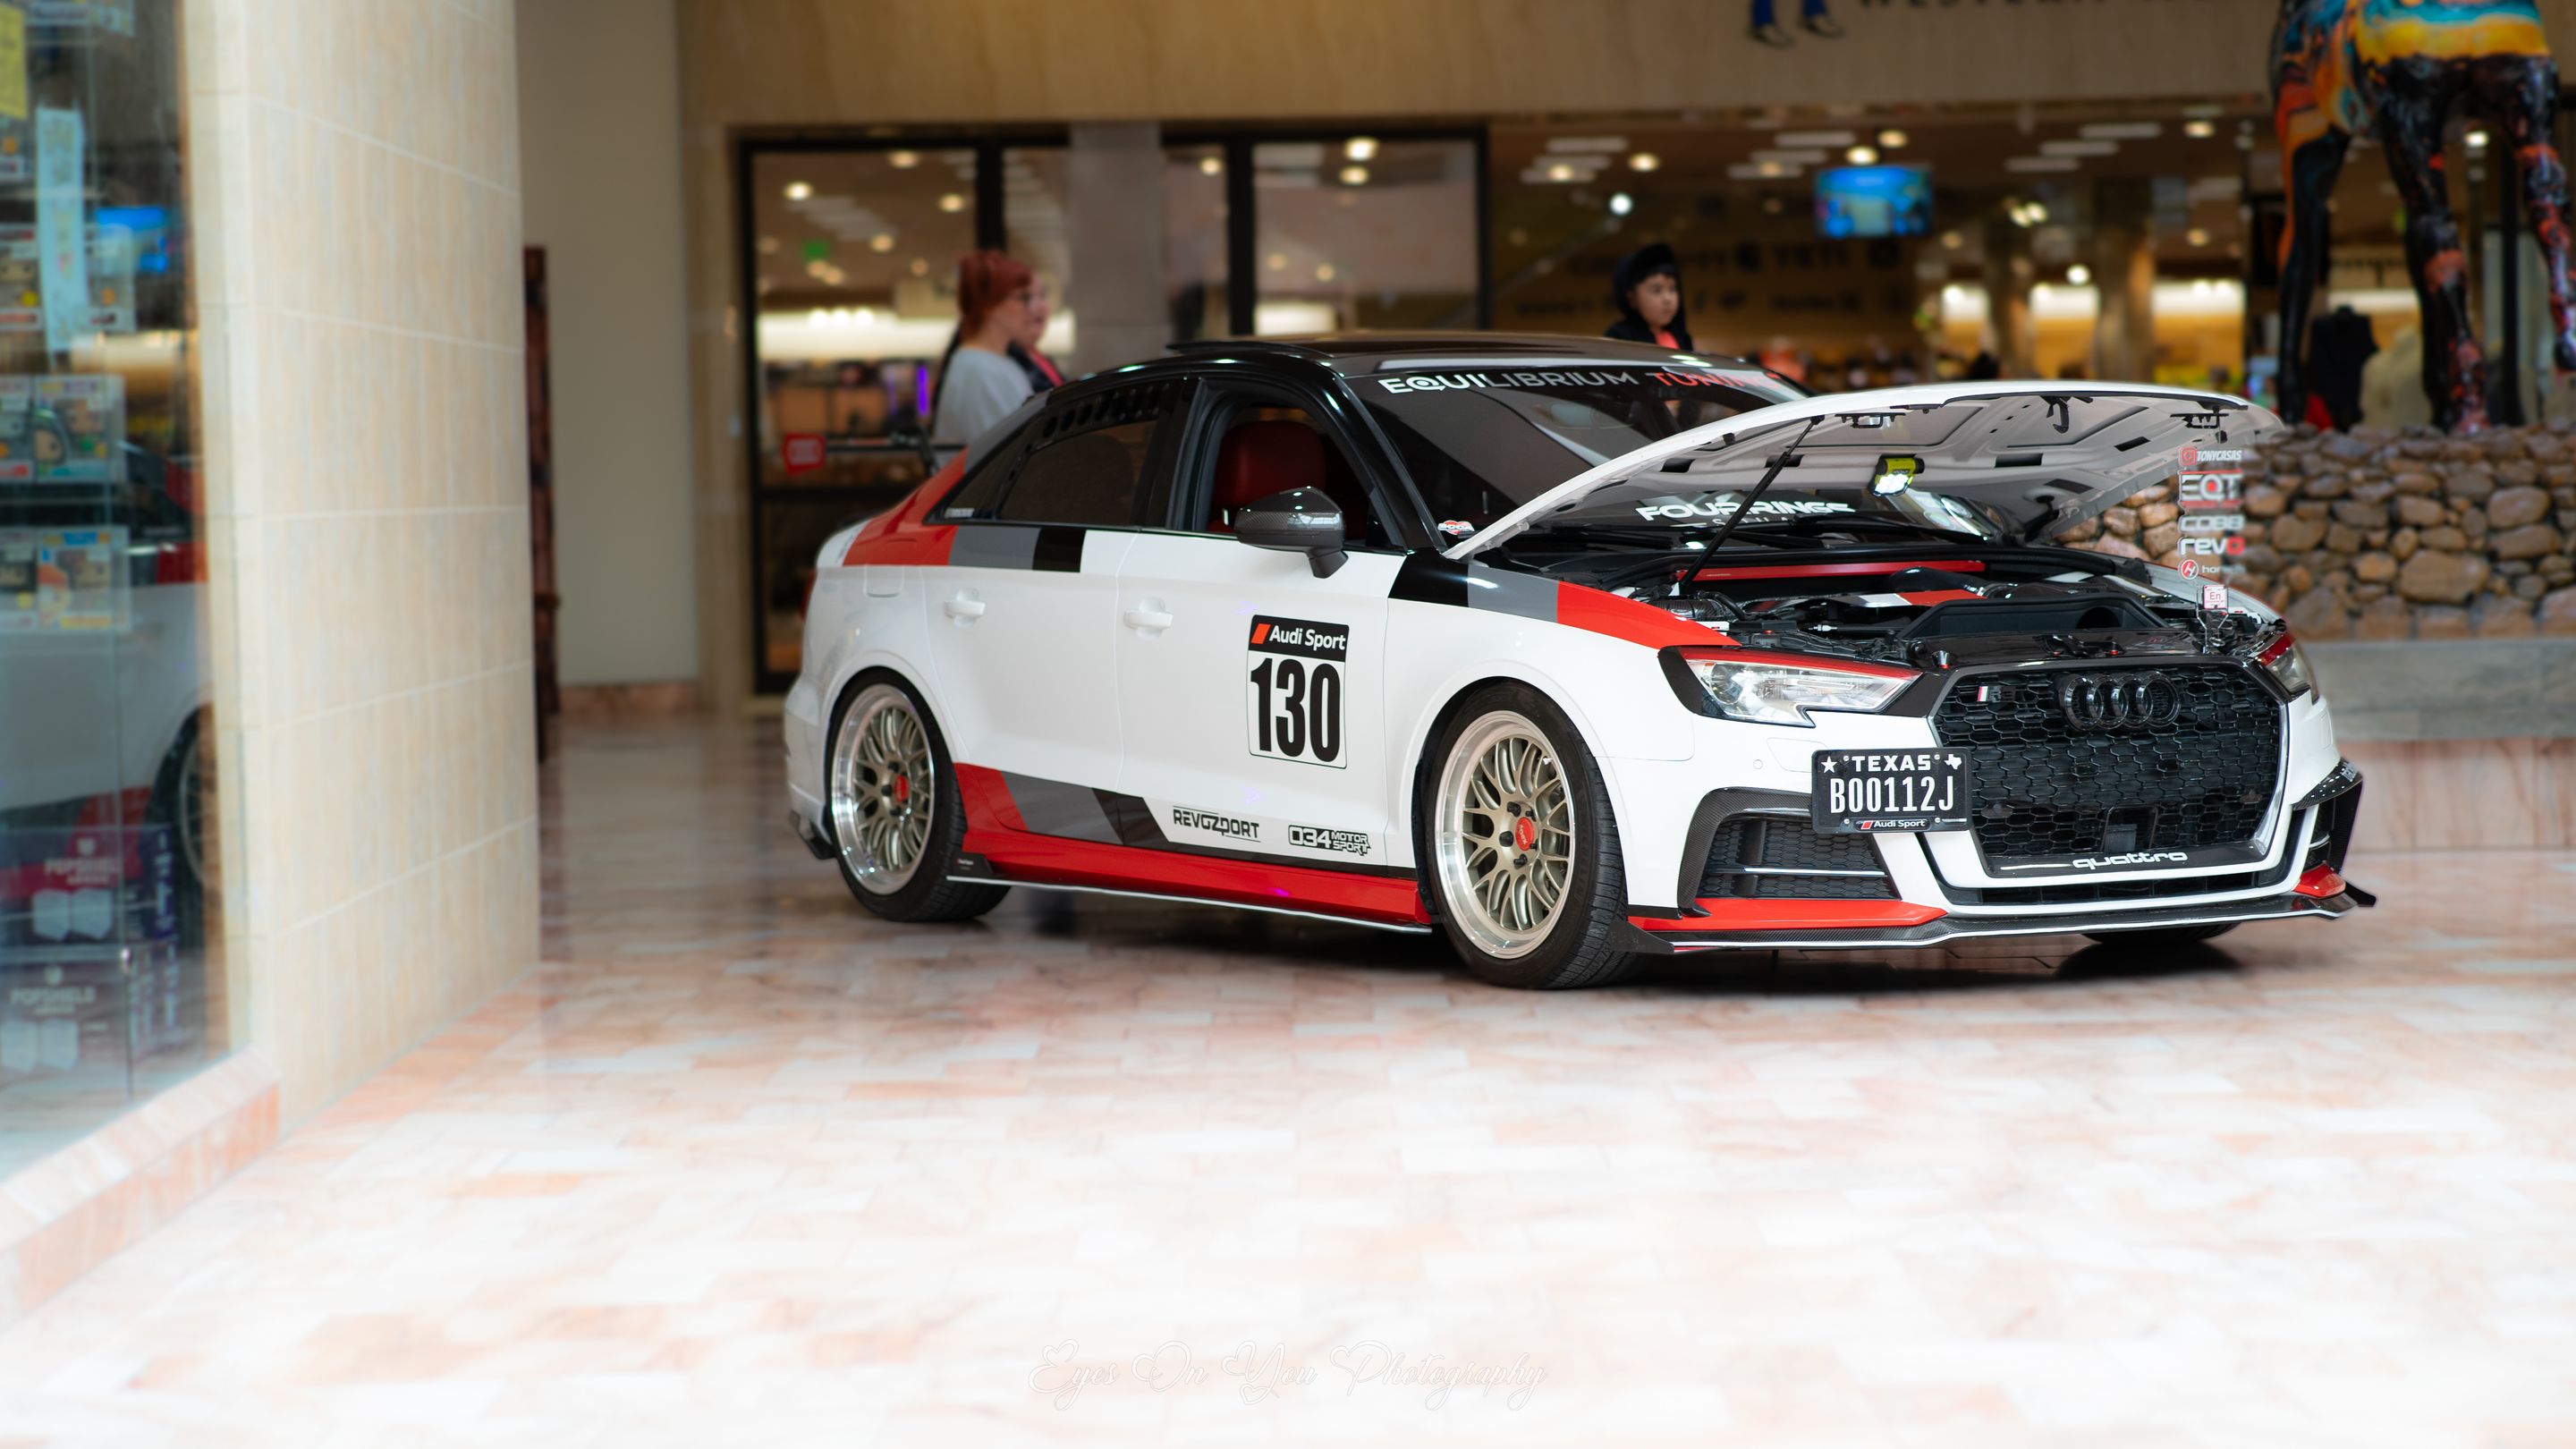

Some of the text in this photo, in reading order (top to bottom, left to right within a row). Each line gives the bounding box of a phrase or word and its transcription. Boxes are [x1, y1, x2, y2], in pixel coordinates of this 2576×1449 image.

[1377, 371, 1780, 394] EQUILIBRIUM TUNING
[2196, 450, 2242, 462] TONYCASAS
[2181, 473, 2243, 502] EQT
[1635, 503, 1744, 521] FOUR
[2180, 537, 2246, 555] revo
[1268, 625, 1346, 651] Audi Sport
[1250, 657, 1341, 762] 130
[1852, 754, 1931, 772] TEXAS
[1873, 819, 1926, 829] Audi Sport
[1289, 826, 1332, 849] 034
[1331, 831, 1368, 844] MOTOR
[1332, 841, 1371, 856] SPORT
[2072, 852, 2189, 870] quattro
